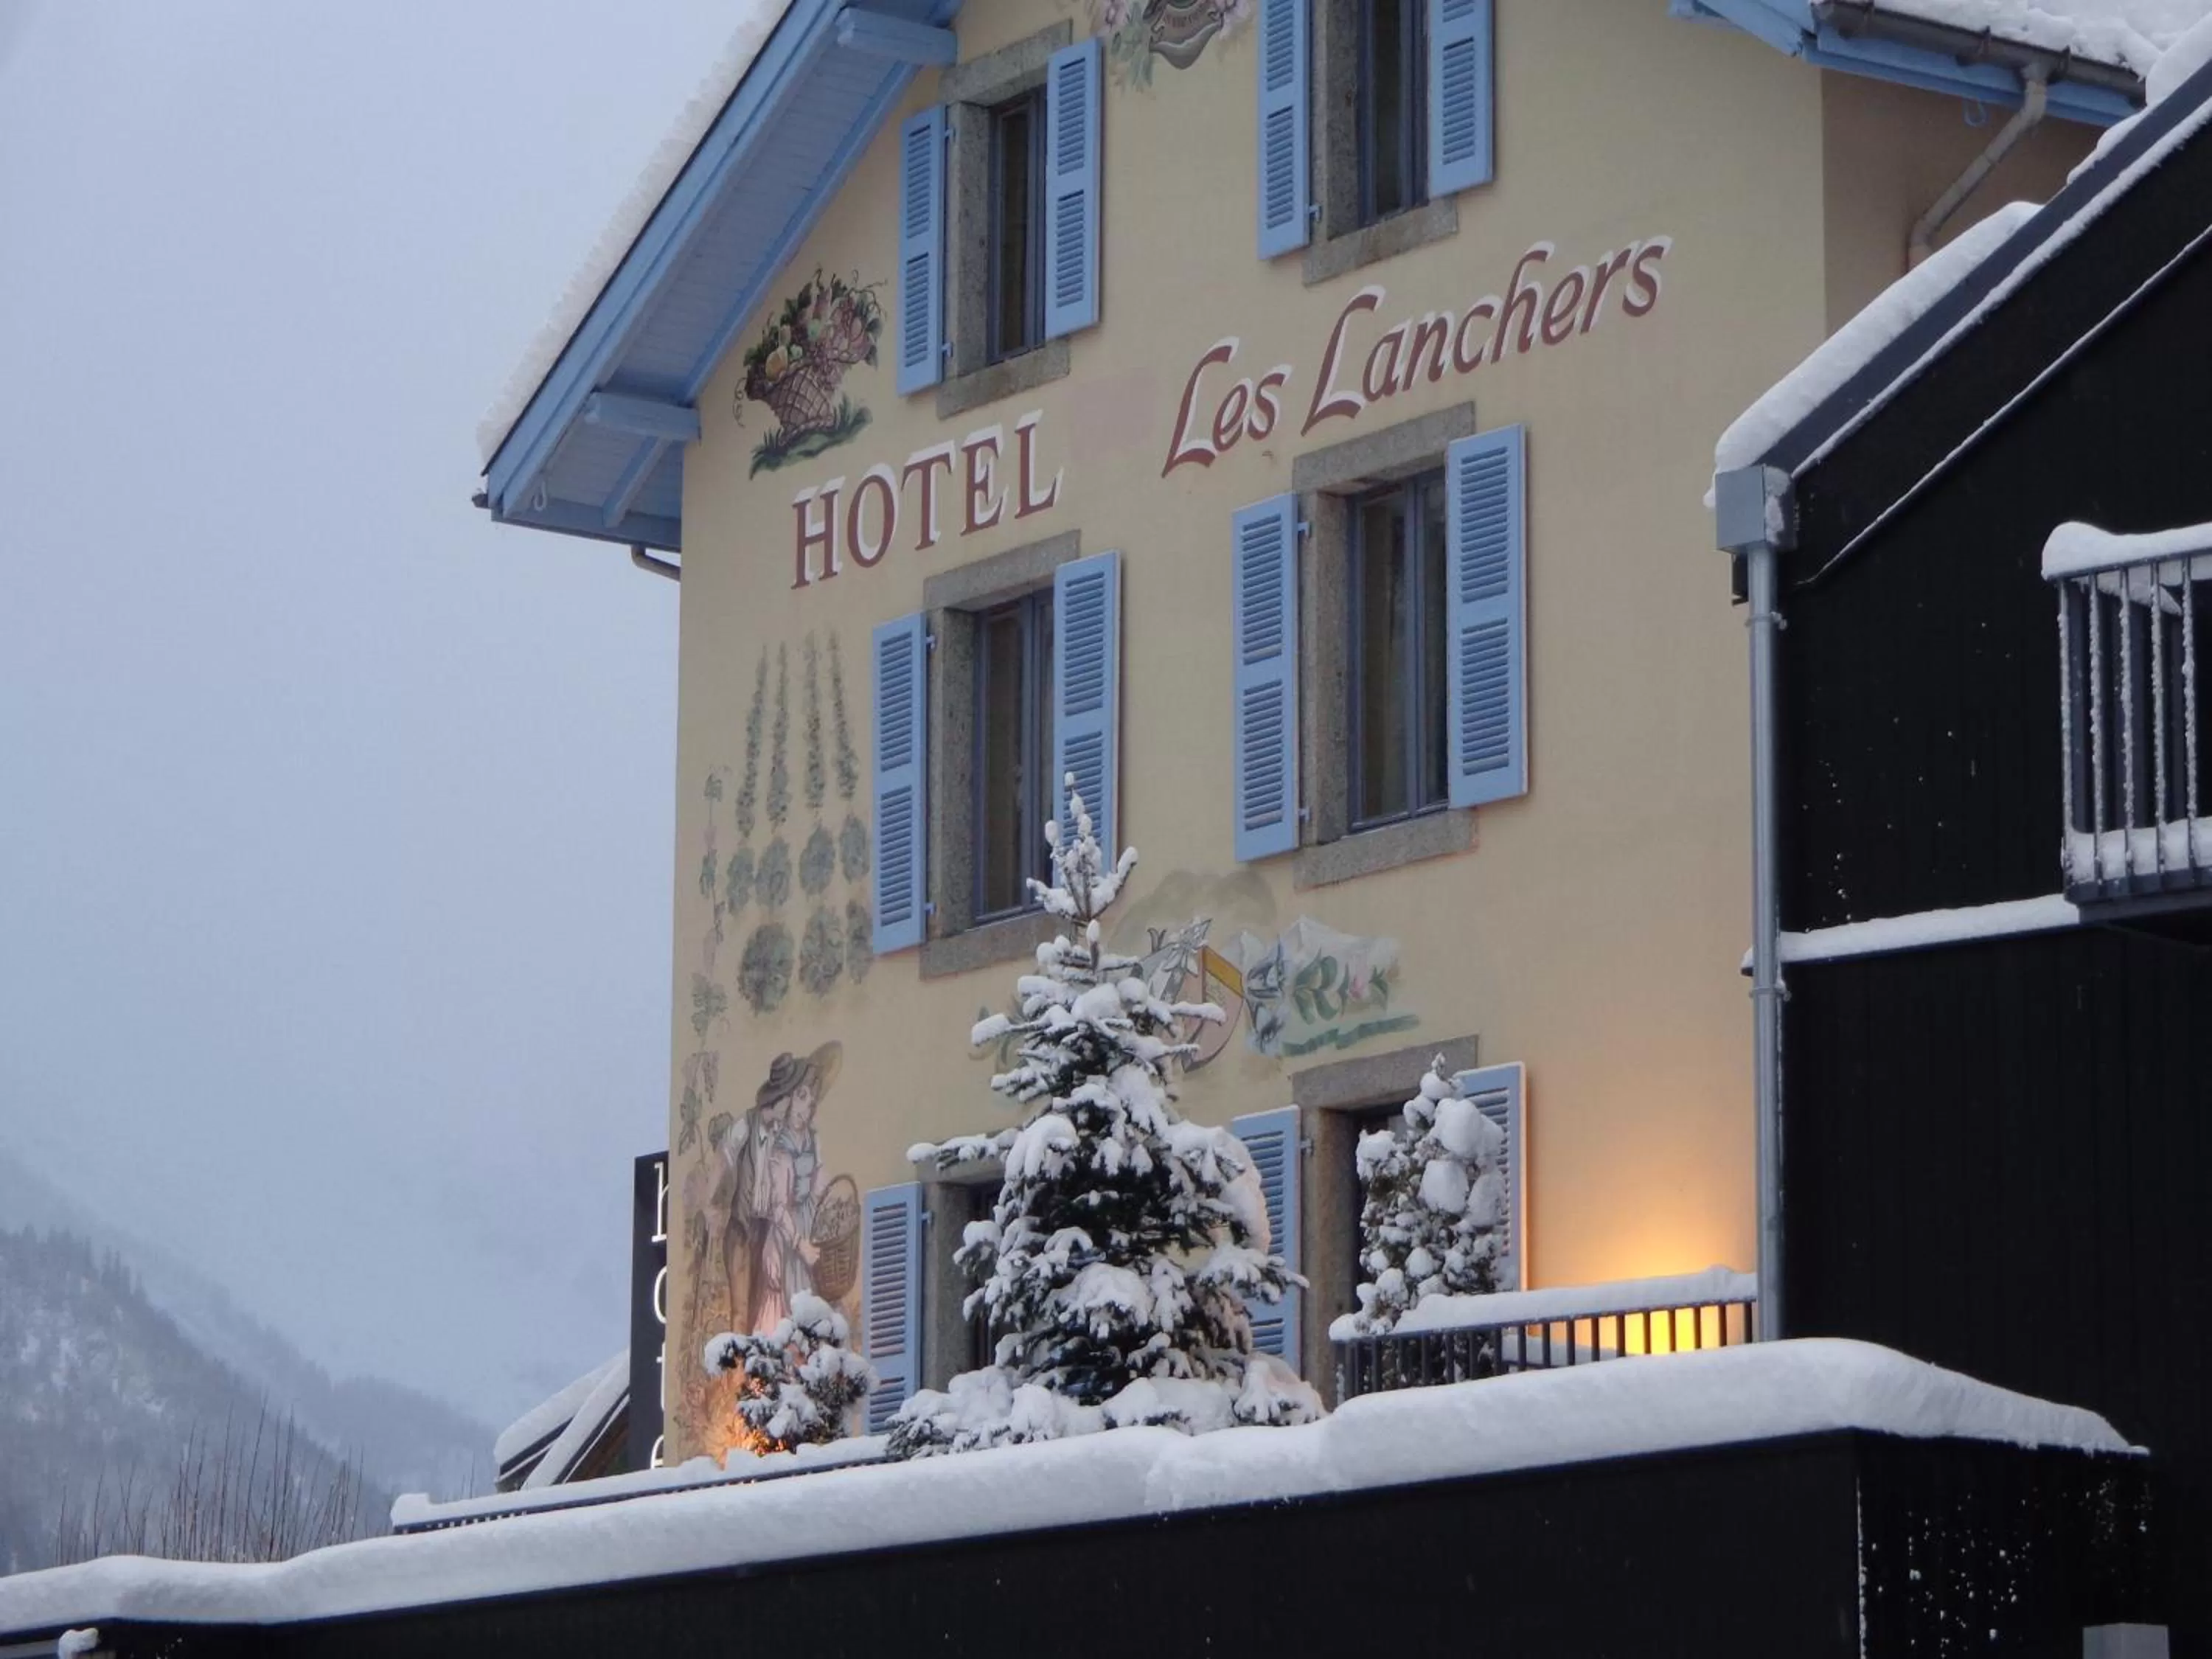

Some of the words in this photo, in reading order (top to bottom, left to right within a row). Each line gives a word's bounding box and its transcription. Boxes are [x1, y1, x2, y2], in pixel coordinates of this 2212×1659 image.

[1161, 335, 1292, 479] Les
[1300, 234, 1673, 437] Lanchers
[790, 409, 1064, 589] HOTEL
